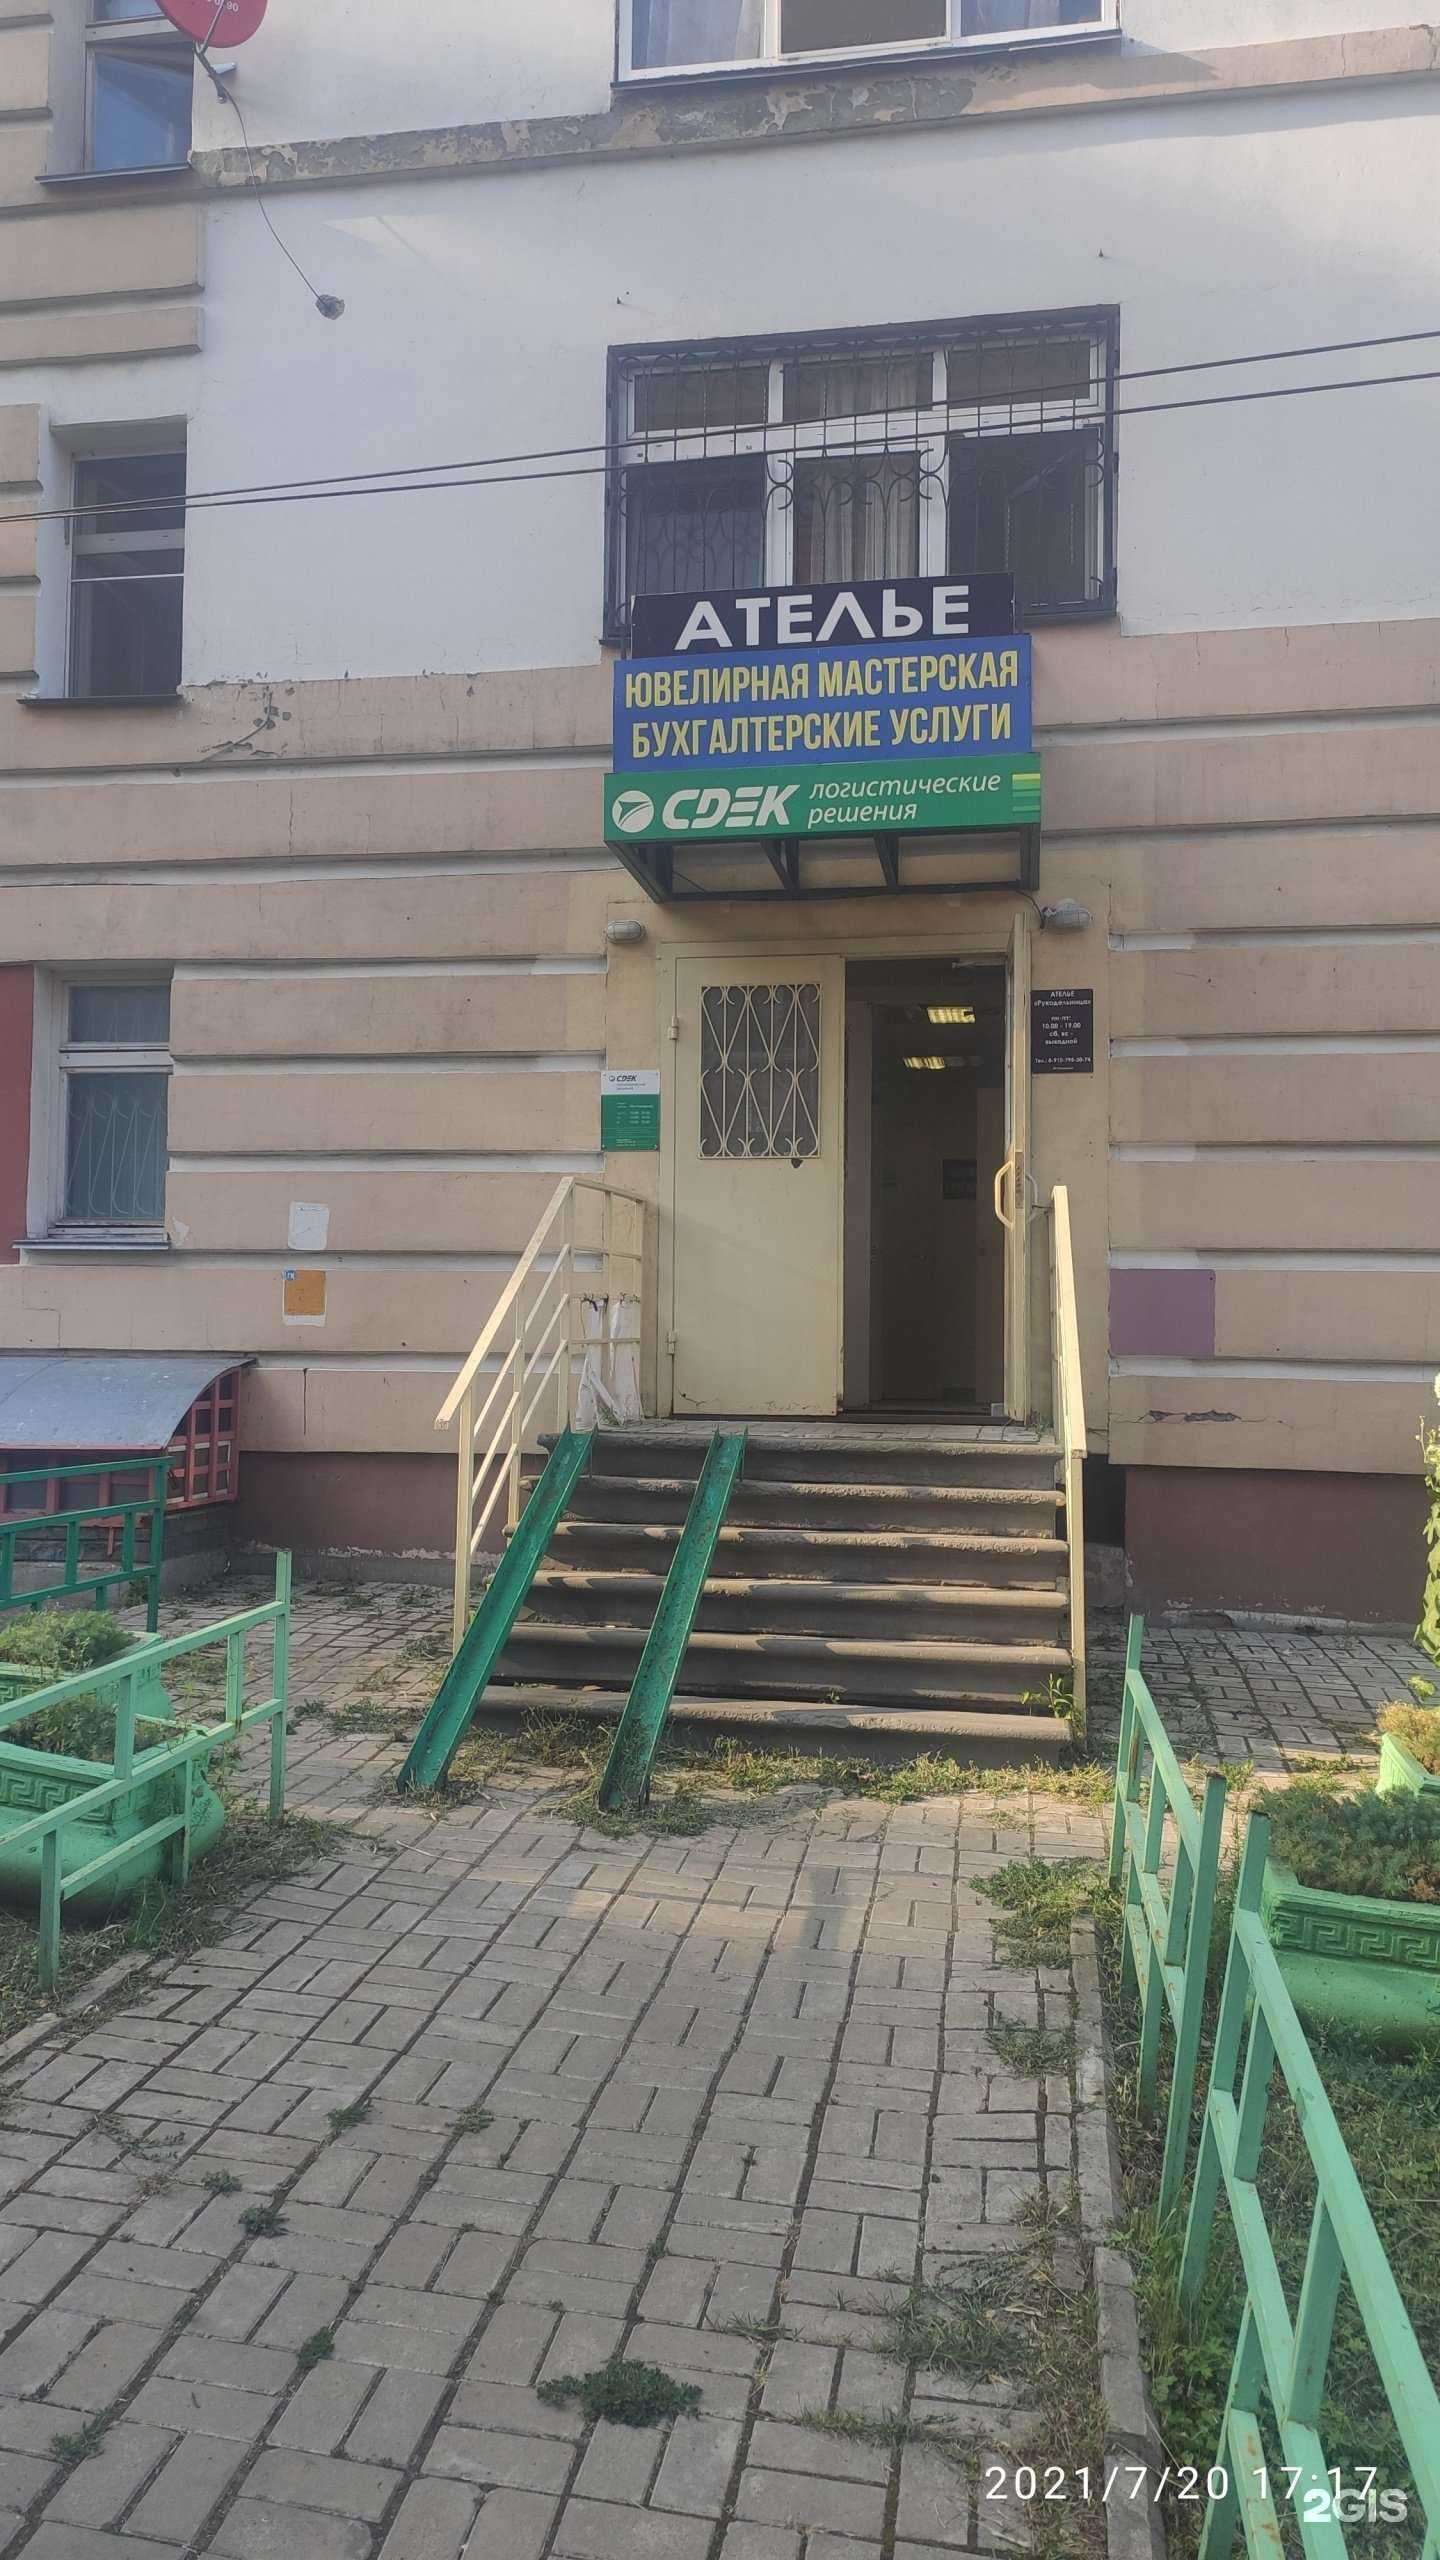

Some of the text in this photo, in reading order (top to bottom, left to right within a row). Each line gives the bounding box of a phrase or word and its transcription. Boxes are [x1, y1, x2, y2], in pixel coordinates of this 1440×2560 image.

[673, 585, 970, 650] АТЕЛЬЕ
[625, 650, 1019, 709] ЮВЕЛИРНАЯ МАСТЕРСКАЯ
[632, 702, 1012, 759] БУХГАЛТЕРСКИЕ УСЛУГИ
[662, 784, 801, 830] CDEK
[809, 773, 1001, 799] логистические
[807, 799, 918, 829] решения
[1050, 990, 1075, 998] АТЕЛЬЕ
